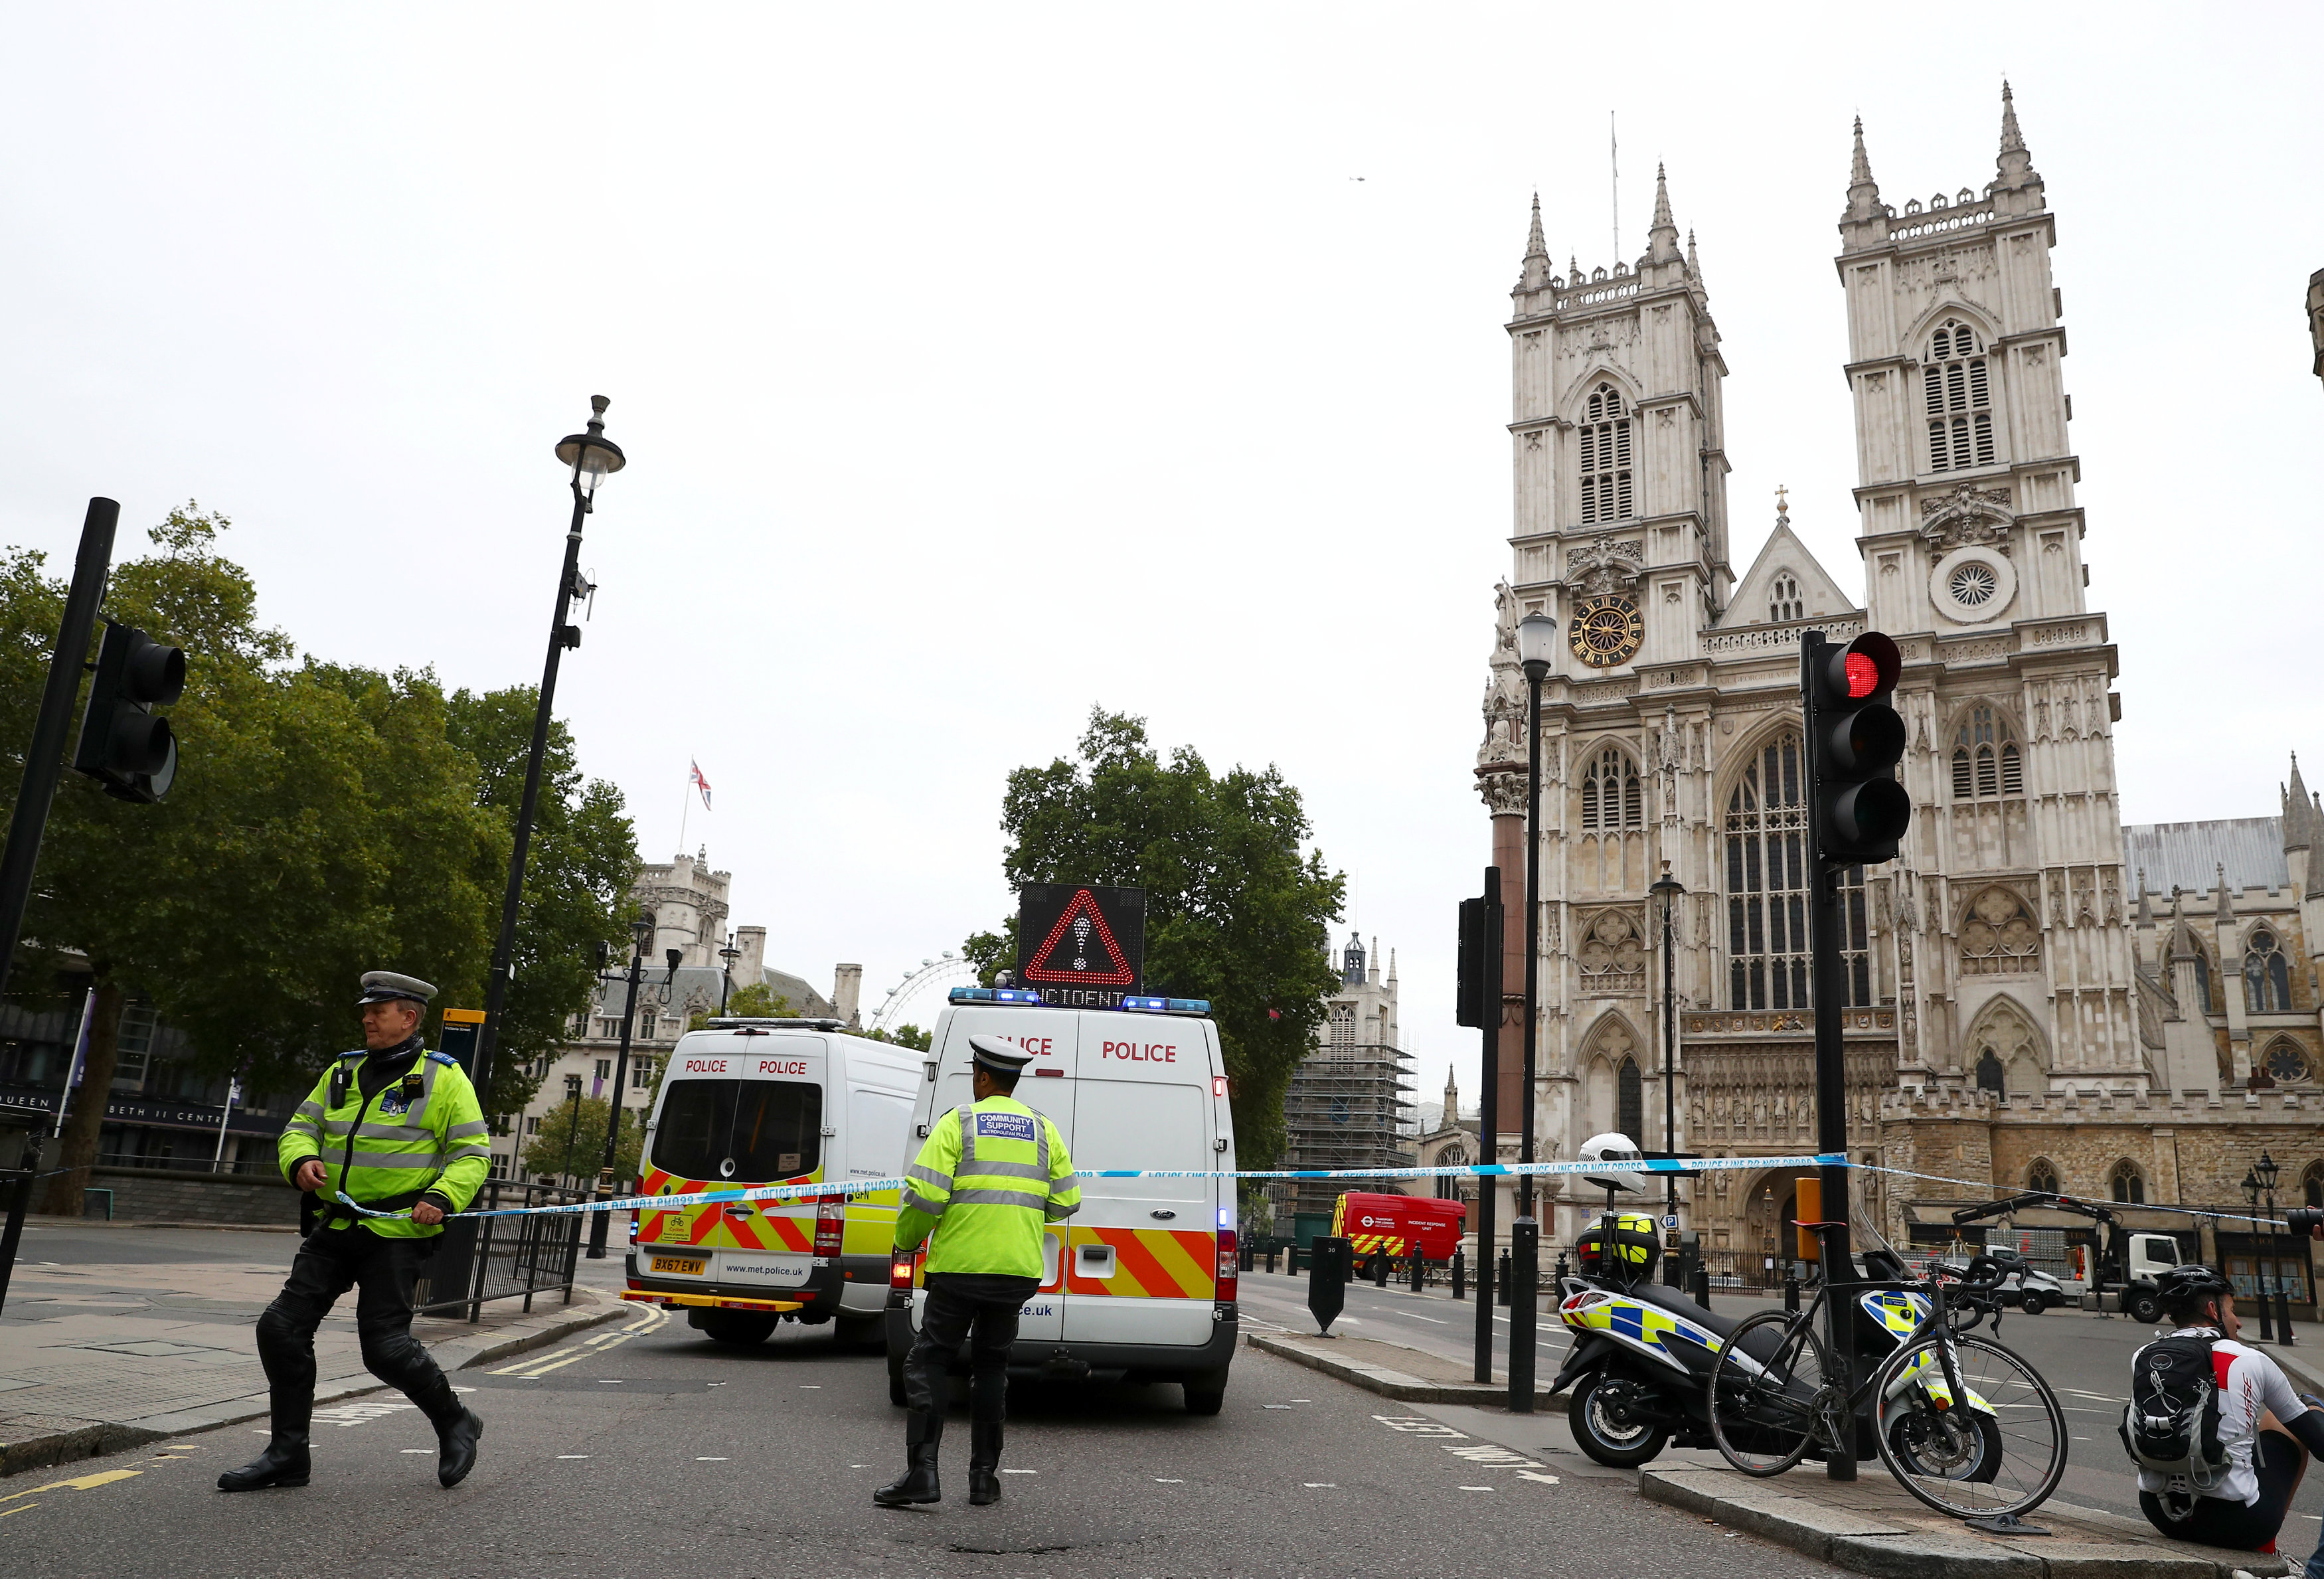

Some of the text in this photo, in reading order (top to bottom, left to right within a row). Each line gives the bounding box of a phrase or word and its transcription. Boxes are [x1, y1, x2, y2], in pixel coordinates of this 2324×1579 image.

[1021, 987, 1124, 1007] NCIDENT
[1102, 1041, 1176, 1062] POLICE
[685, 1060, 728, 1072] POLICE
[759, 1061, 807, 1074] POLICE
[0, 1096, 49, 1107] UEEN
[979, 1115, 1031, 1125] COMMUNITY
[986, 1122, 1026, 1133] SUPPORT
[655, 1258, 702, 1273] BX67 EWV
[726, 1265, 803, 1276] www.met.police.uk
[1944, 1338, 1966, 1393] TIME
